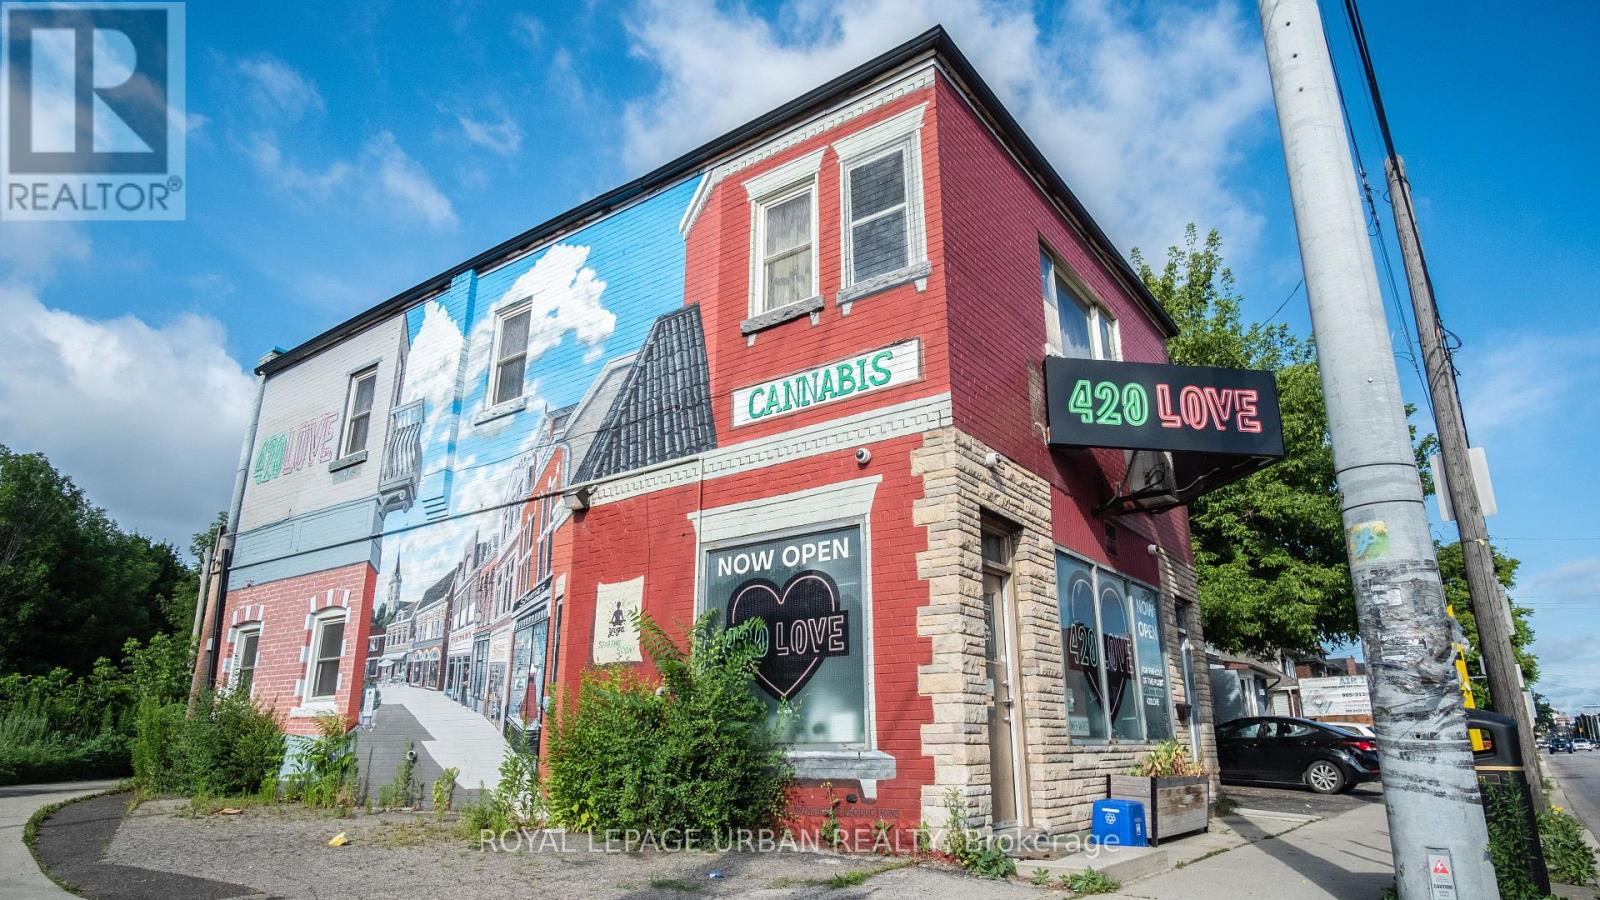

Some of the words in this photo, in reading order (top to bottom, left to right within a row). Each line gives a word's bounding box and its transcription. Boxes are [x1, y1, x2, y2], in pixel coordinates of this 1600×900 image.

[748, 350, 894, 420] CANNABIS
[1068, 379, 1149, 428] 420
[1155, 383, 1263, 434] LOVE
[717, 549, 775, 577] NOW
[781, 537, 849, 568] OPEN
[1135, 599, 1157, 618] NOW
[775, 615, 846, 656] LOVE
[1069, 623, 1099, 667] 420
[1105, 633, 1135, 675] OVE
[1137, 620, 1159, 641] OPEN
